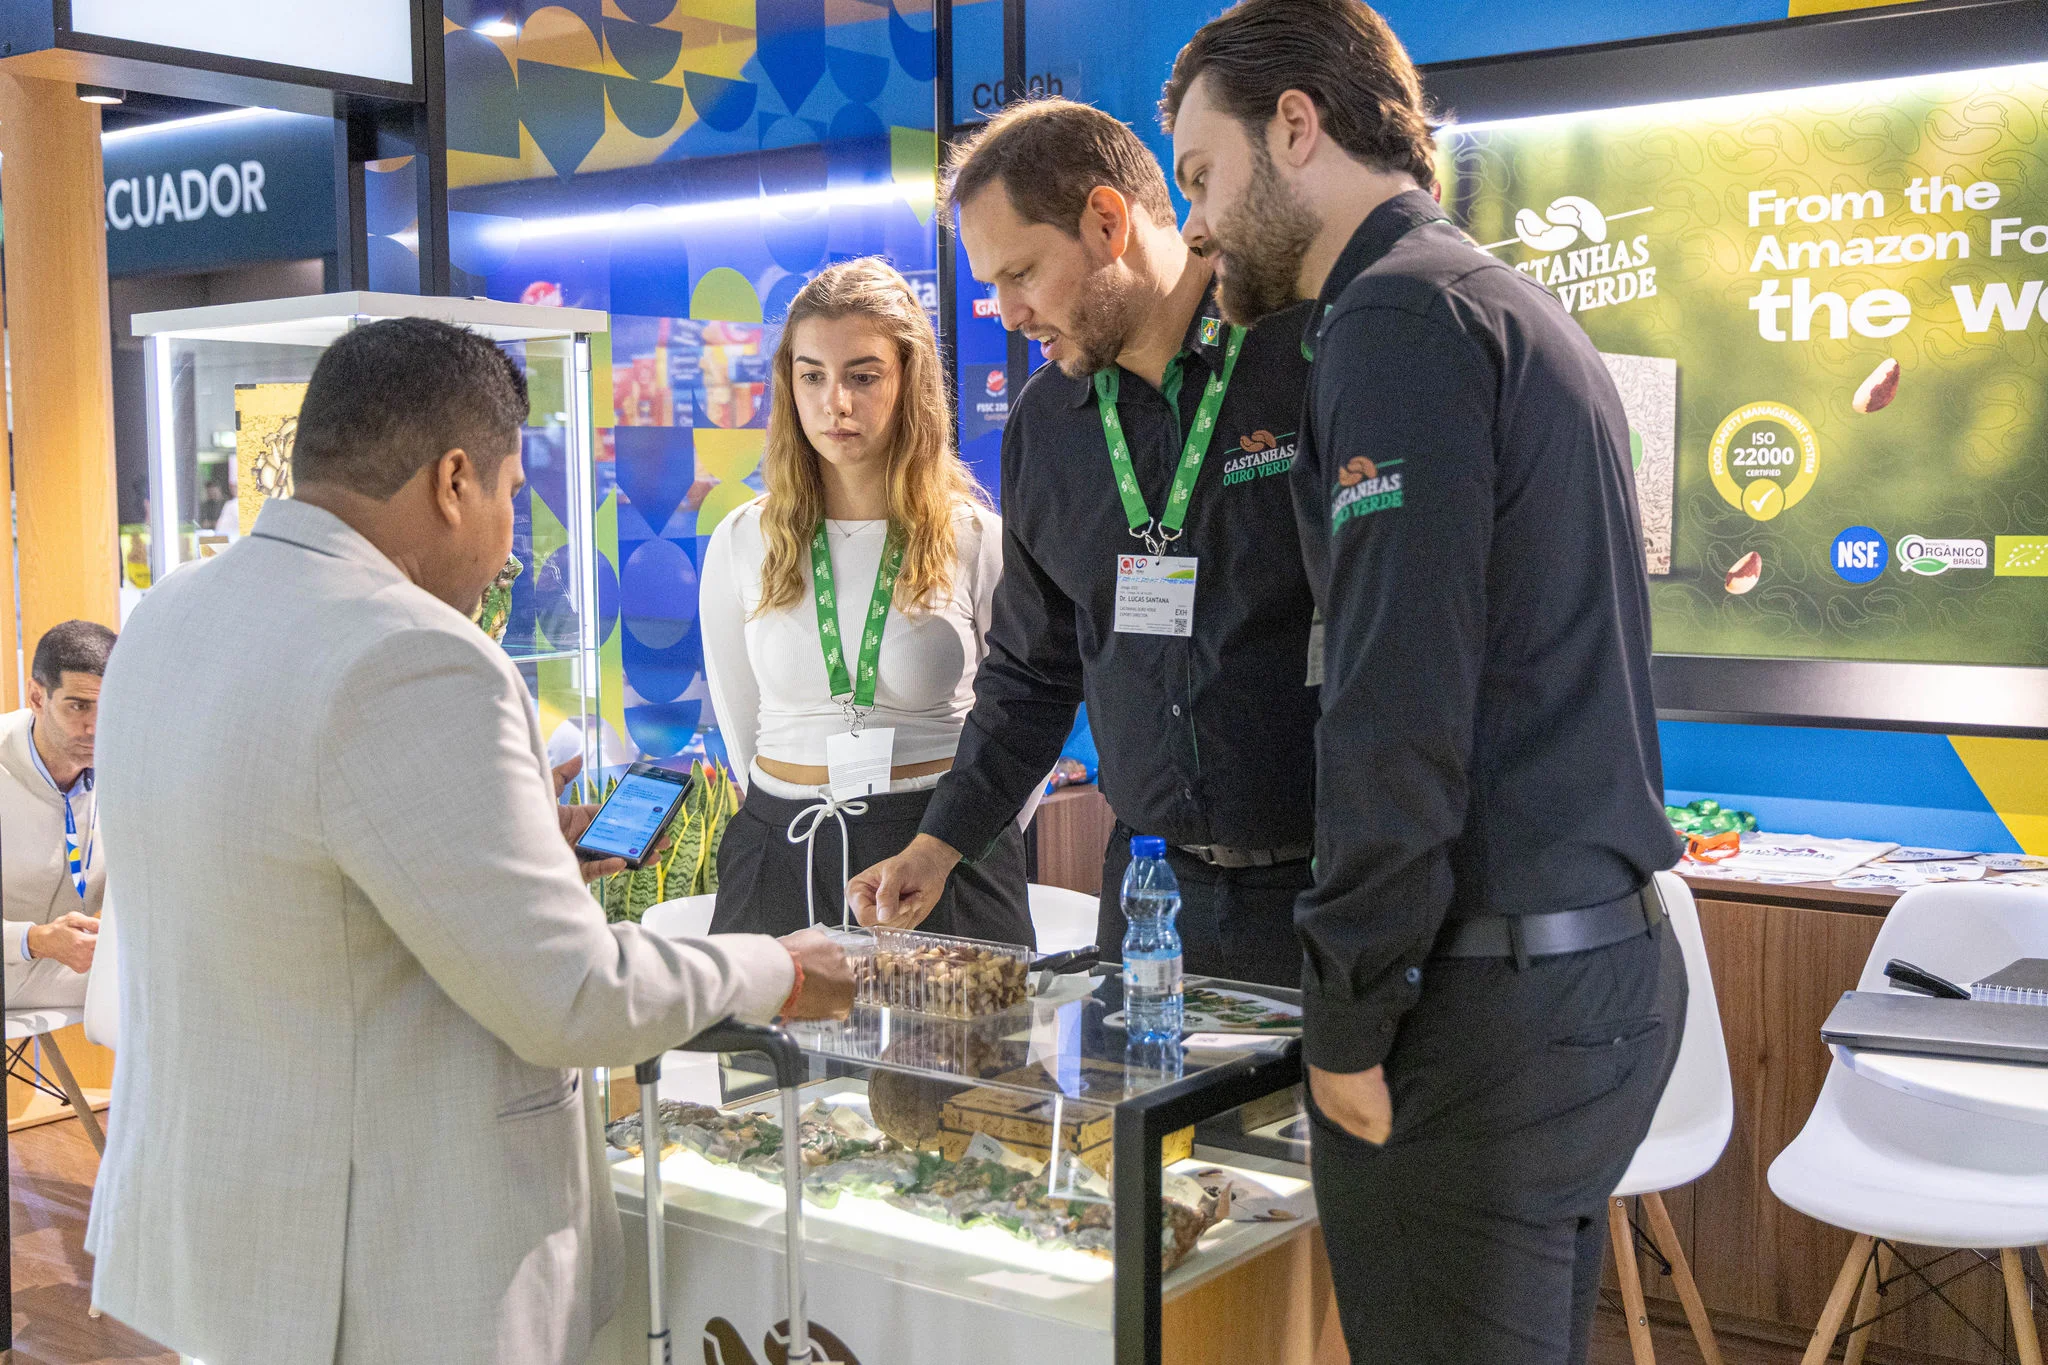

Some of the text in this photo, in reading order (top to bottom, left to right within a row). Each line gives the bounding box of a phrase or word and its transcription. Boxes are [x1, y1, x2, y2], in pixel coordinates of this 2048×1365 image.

[105, 160, 268, 231] CUADOR
[1749, 176, 2001, 228] From the
[1750, 217, 2048, 272] Amazon Fo
[1557, 266, 1657, 313] VERDE
[1749, 277, 2048, 342] the w
[1713, 406, 1816, 476] FOOD SAFETY MANAGEMENT SYSTEM
[1751, 432, 1776, 445] ISO
[1223, 443, 1296, 474] CASTANHAS
[1733, 447, 1795, 466] 22000
[1222, 457, 1294, 487] OURO VERD
[1745, 469, 1781, 477] CERTIFIED
[1838, 540, 1880, 569] NSF
[1907, 543, 1984, 560] ORGÂNICO
[1953, 558, 1984, 566] BRASIL
[1175, 608, 1188, 616] EXH
